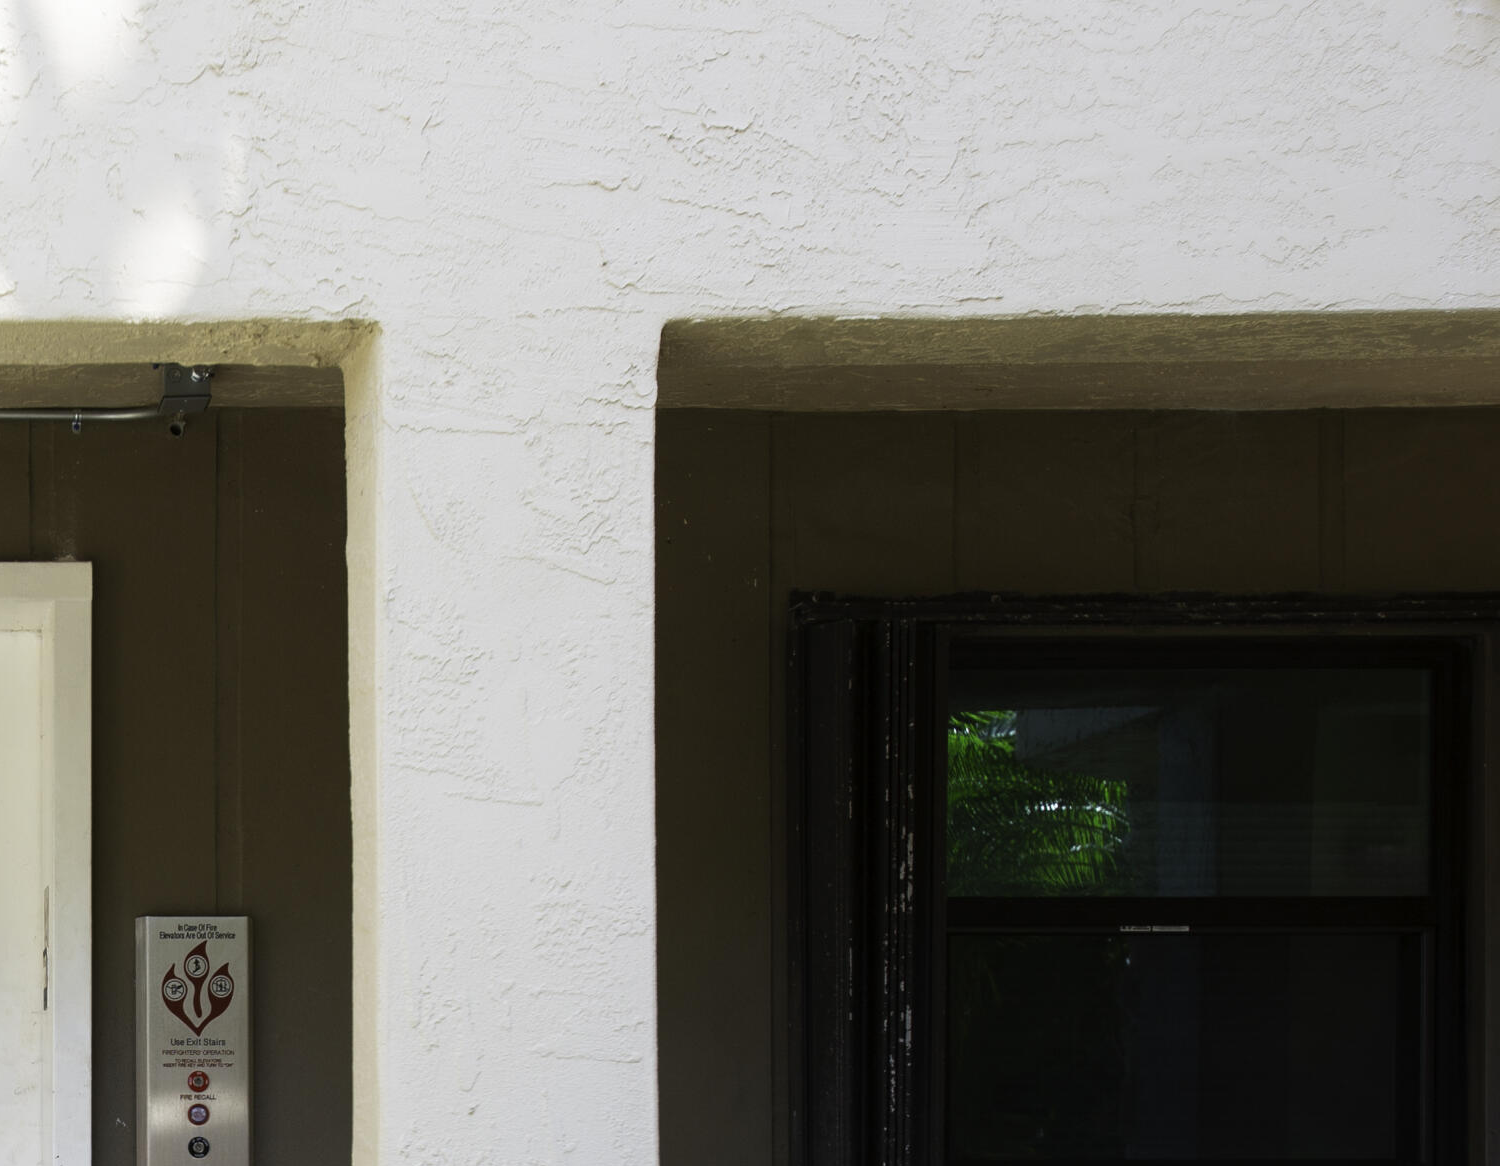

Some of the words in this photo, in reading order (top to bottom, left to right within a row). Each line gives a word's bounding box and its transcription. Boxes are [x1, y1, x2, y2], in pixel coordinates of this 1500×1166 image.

[184, 924, 197, 932] Case
[198, 924, 205, 932] Of
[206, 924, 217, 932] Fire
[160, 931, 184, 939] Elevators
[186, 931, 195, 939] Are
[196, 931, 206, 939] Out
[207, 931, 214, 939] Of
[215, 931, 235, 939] Service
[170, 1038, 184, 1046] Use
[187, 1038, 201, 1046] Exit
[204, 1038, 226, 1046] Stairs
